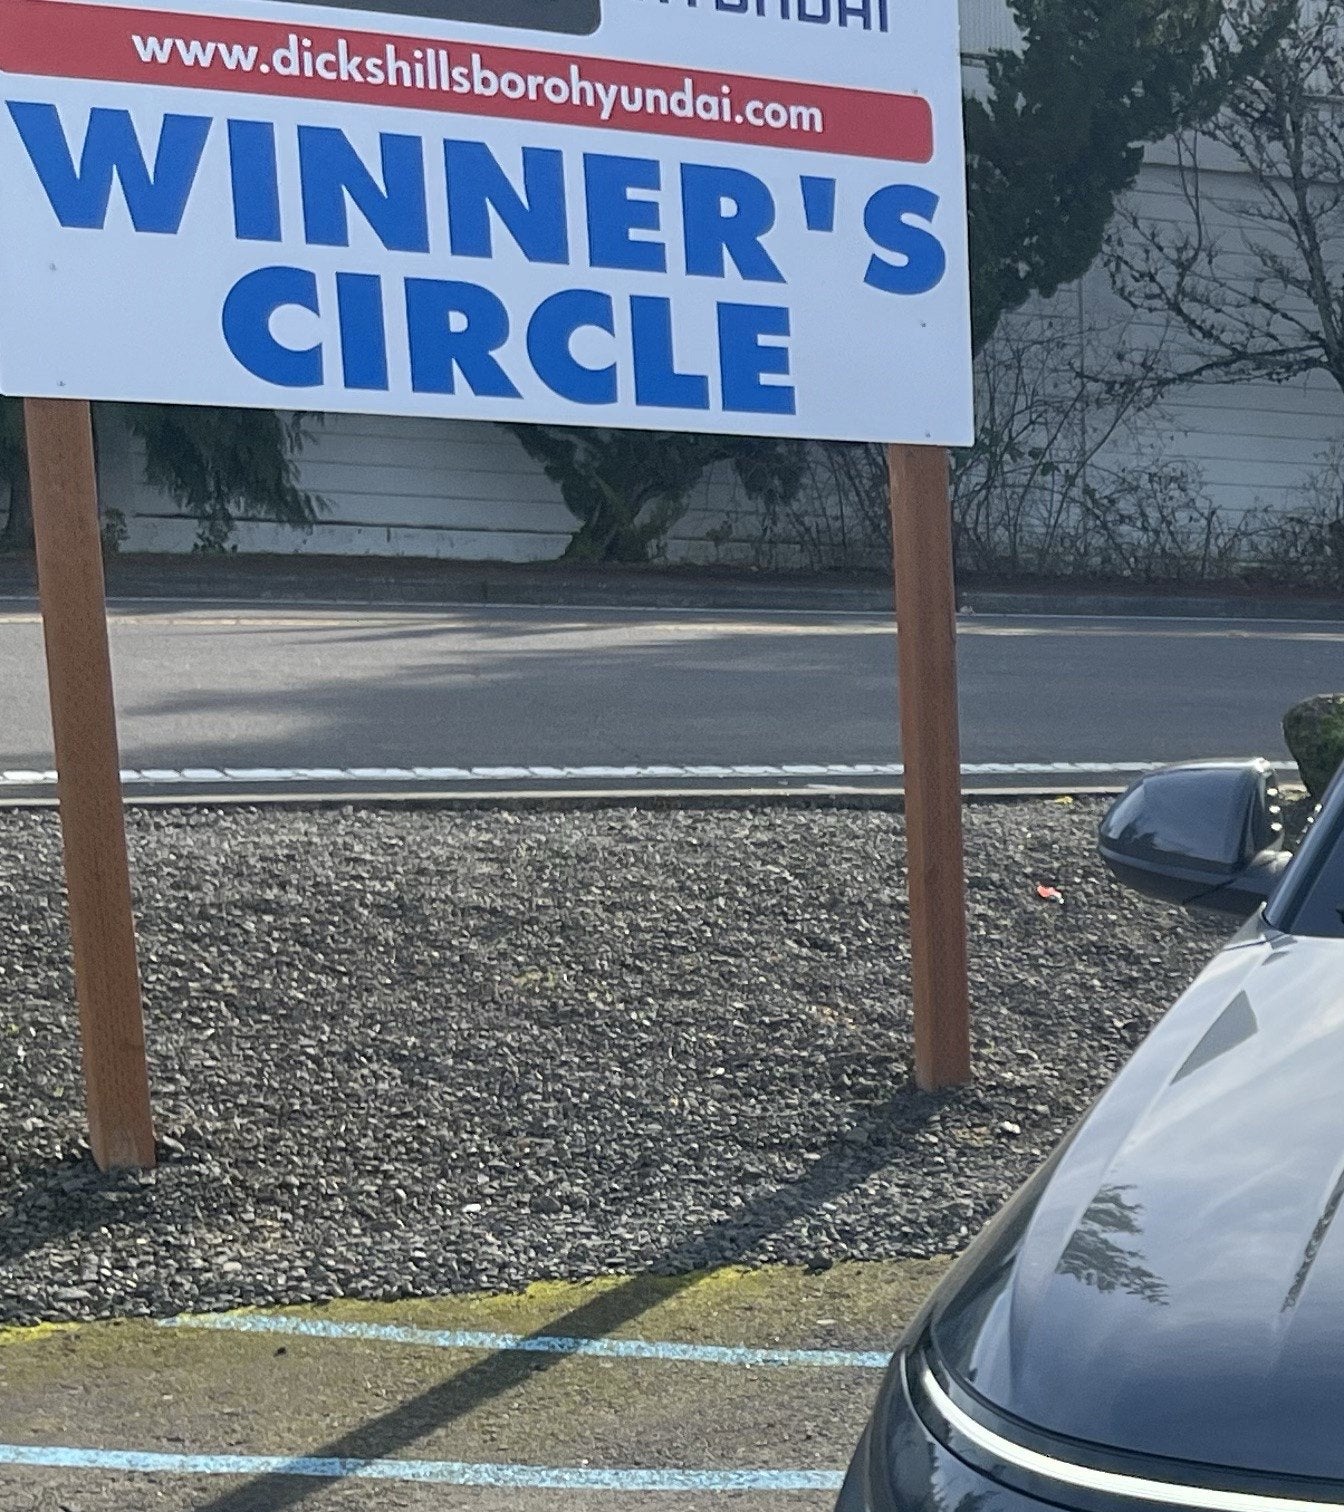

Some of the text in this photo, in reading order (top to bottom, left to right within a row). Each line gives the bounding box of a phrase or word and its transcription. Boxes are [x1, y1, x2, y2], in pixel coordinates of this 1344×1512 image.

[131, 30, 824, 135] www.dickshillsborohyundai.com
[5, 100, 947, 296] WINNER'S
[221, 265, 796, 416] CIRCLE
